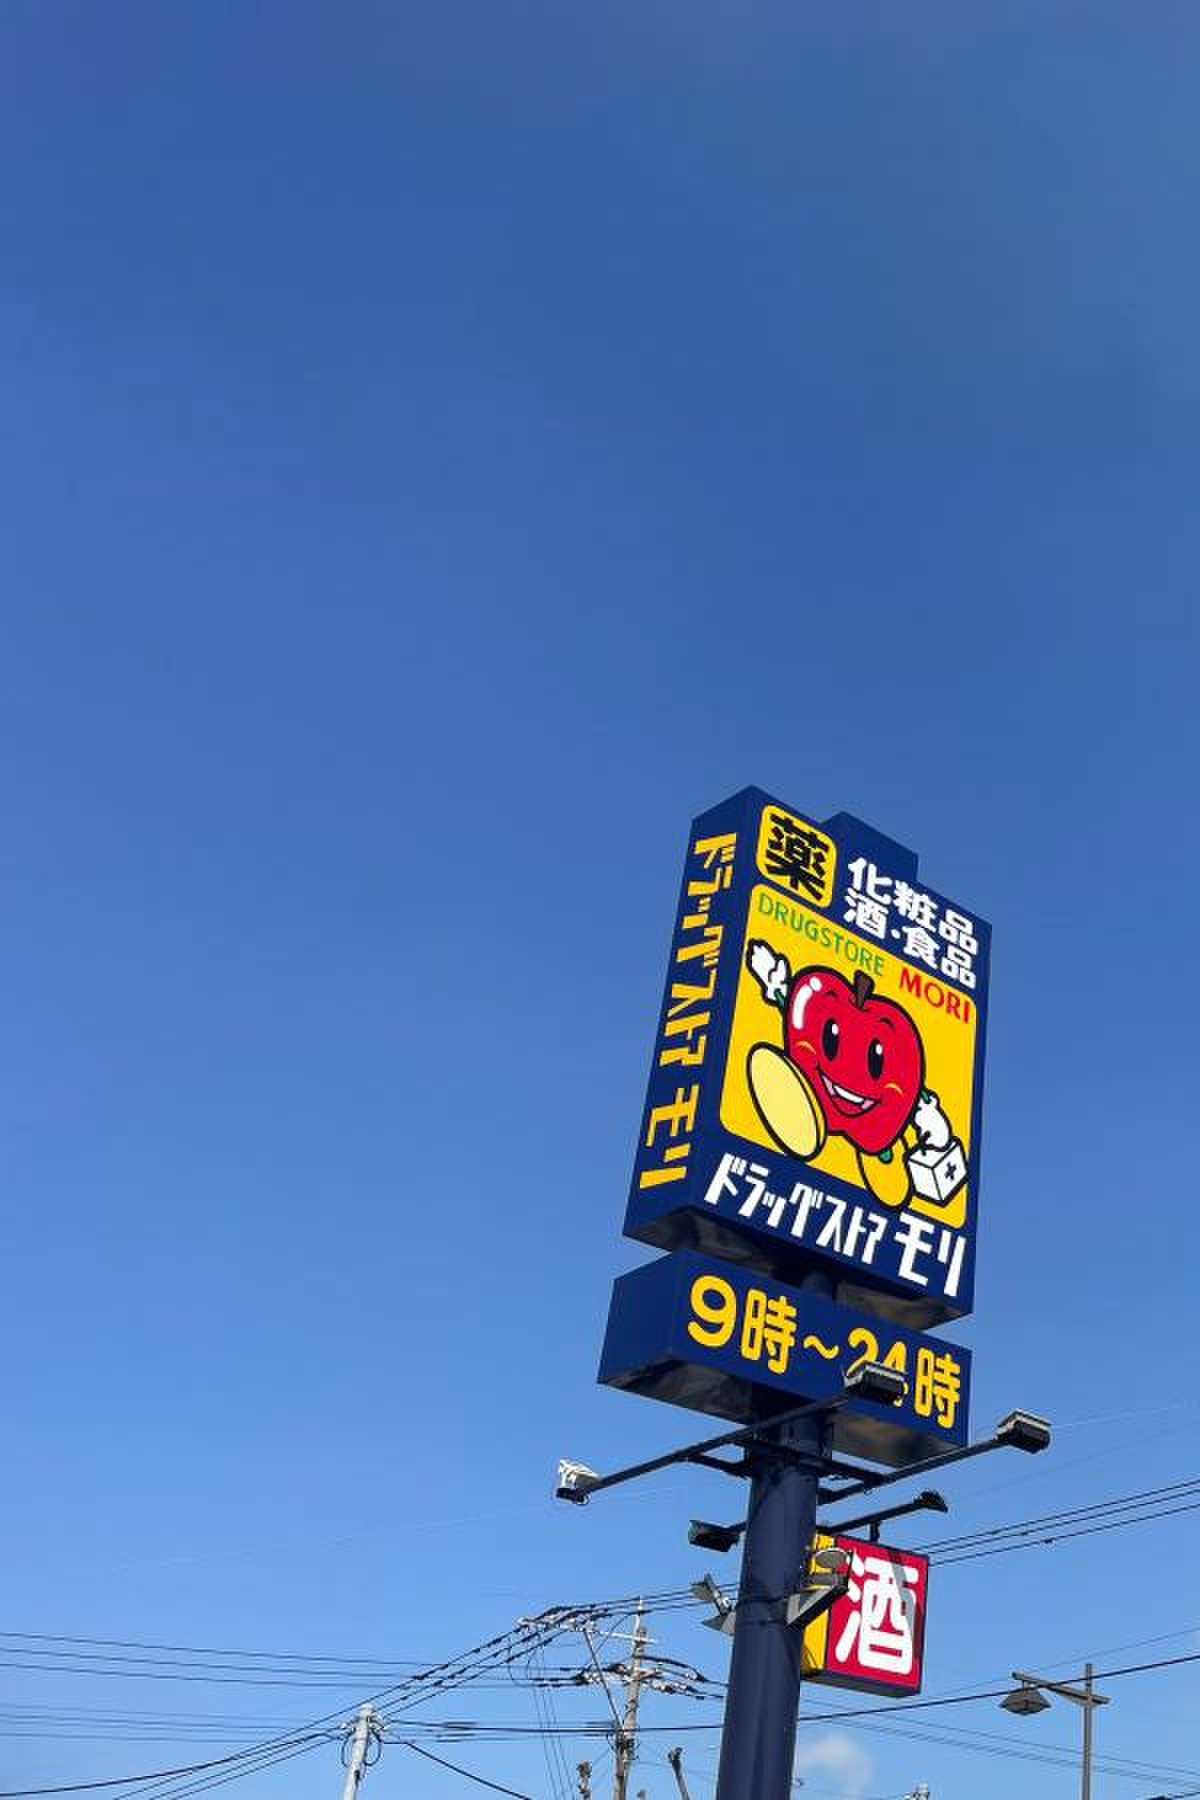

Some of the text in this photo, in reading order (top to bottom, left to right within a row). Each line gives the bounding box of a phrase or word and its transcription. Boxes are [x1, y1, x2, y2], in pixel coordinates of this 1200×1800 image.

[766, 812, 829, 900] 薬
[848, 857, 978, 955] 化粧品
[639, 831, 737, 1190] ドラッグストア モリ
[758, 893, 970, 1024] DRUGSTORE MORI
[703, 1151, 966, 1297] ドラッグストア モリ
[835, 1550, 919, 1675] 酒
